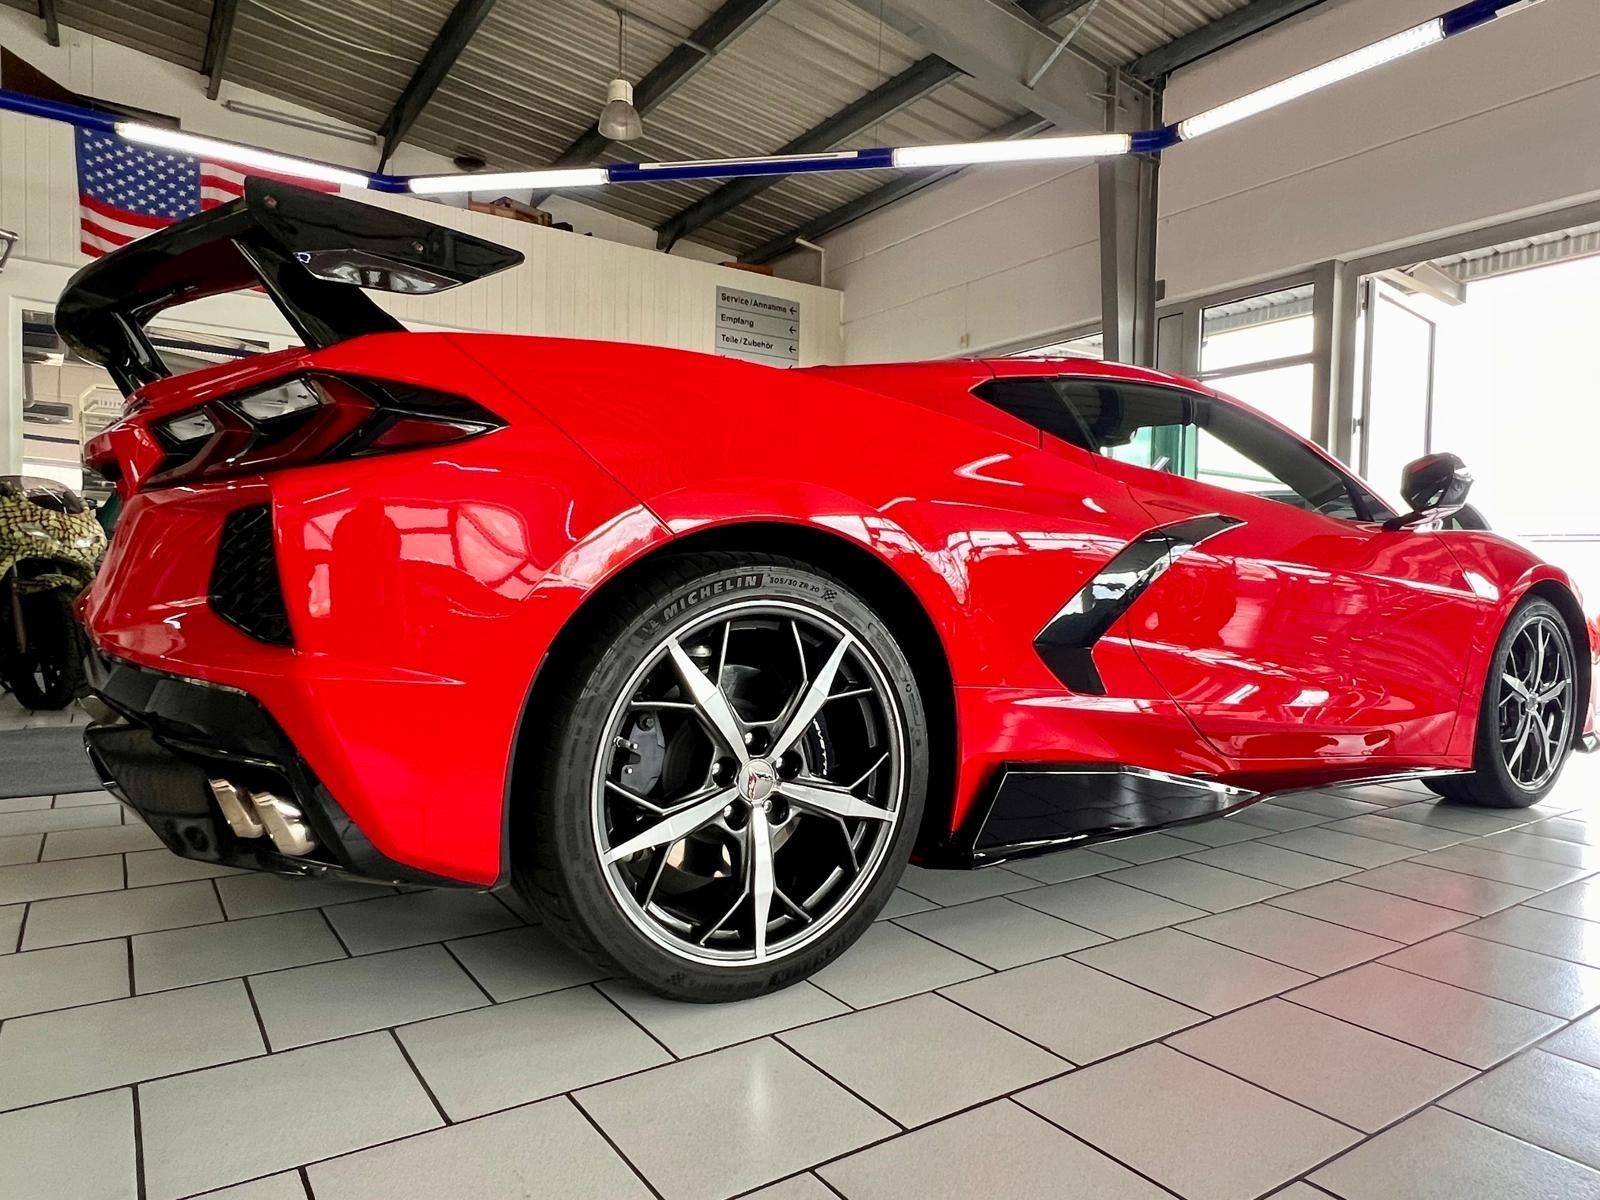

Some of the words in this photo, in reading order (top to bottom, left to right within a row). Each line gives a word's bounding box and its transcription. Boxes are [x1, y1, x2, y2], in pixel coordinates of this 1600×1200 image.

[720, 313, 754, 328] Empfang
[769, 577, 797, 587] 305/30
[663, 576, 757, 620] MICHELIN
